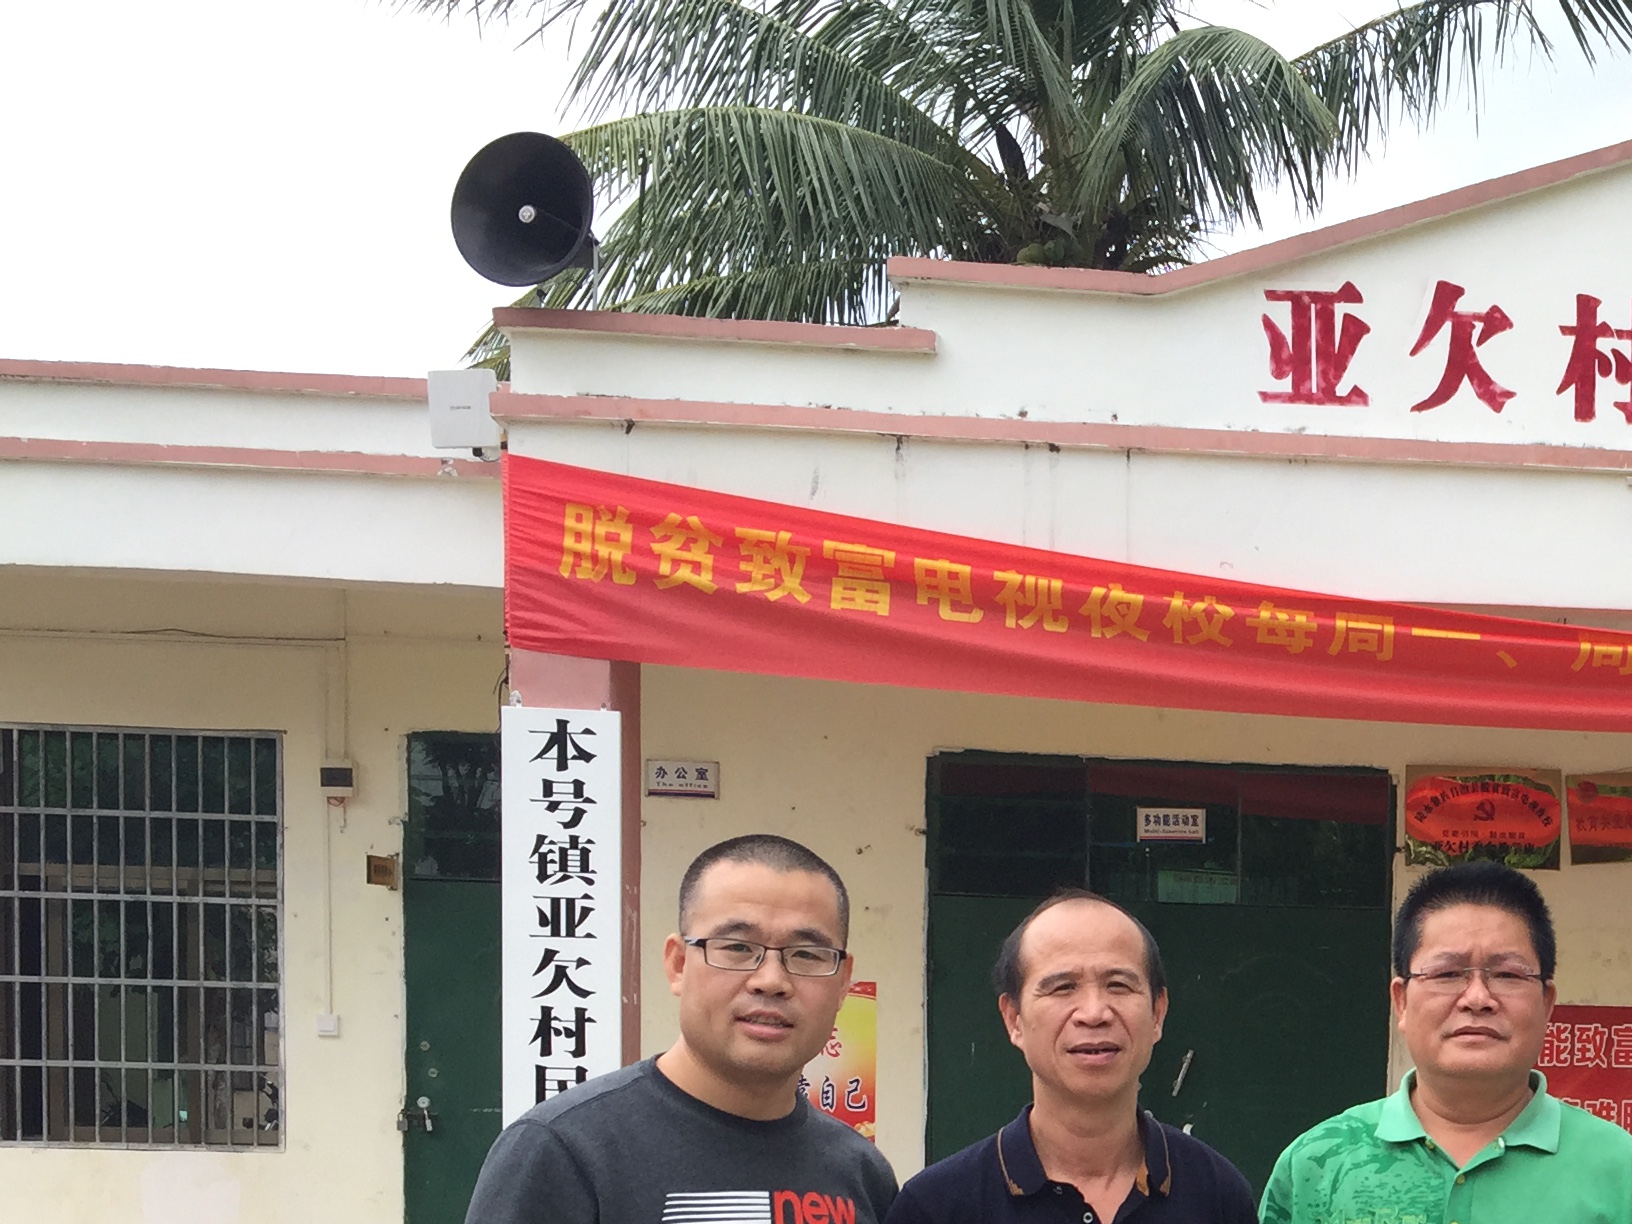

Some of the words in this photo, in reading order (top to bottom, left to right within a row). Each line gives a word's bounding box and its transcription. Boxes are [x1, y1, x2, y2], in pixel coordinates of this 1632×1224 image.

[655, 766, 709, 781] 办公室
[1144, 814, 1200, 827] 多功能活动室
